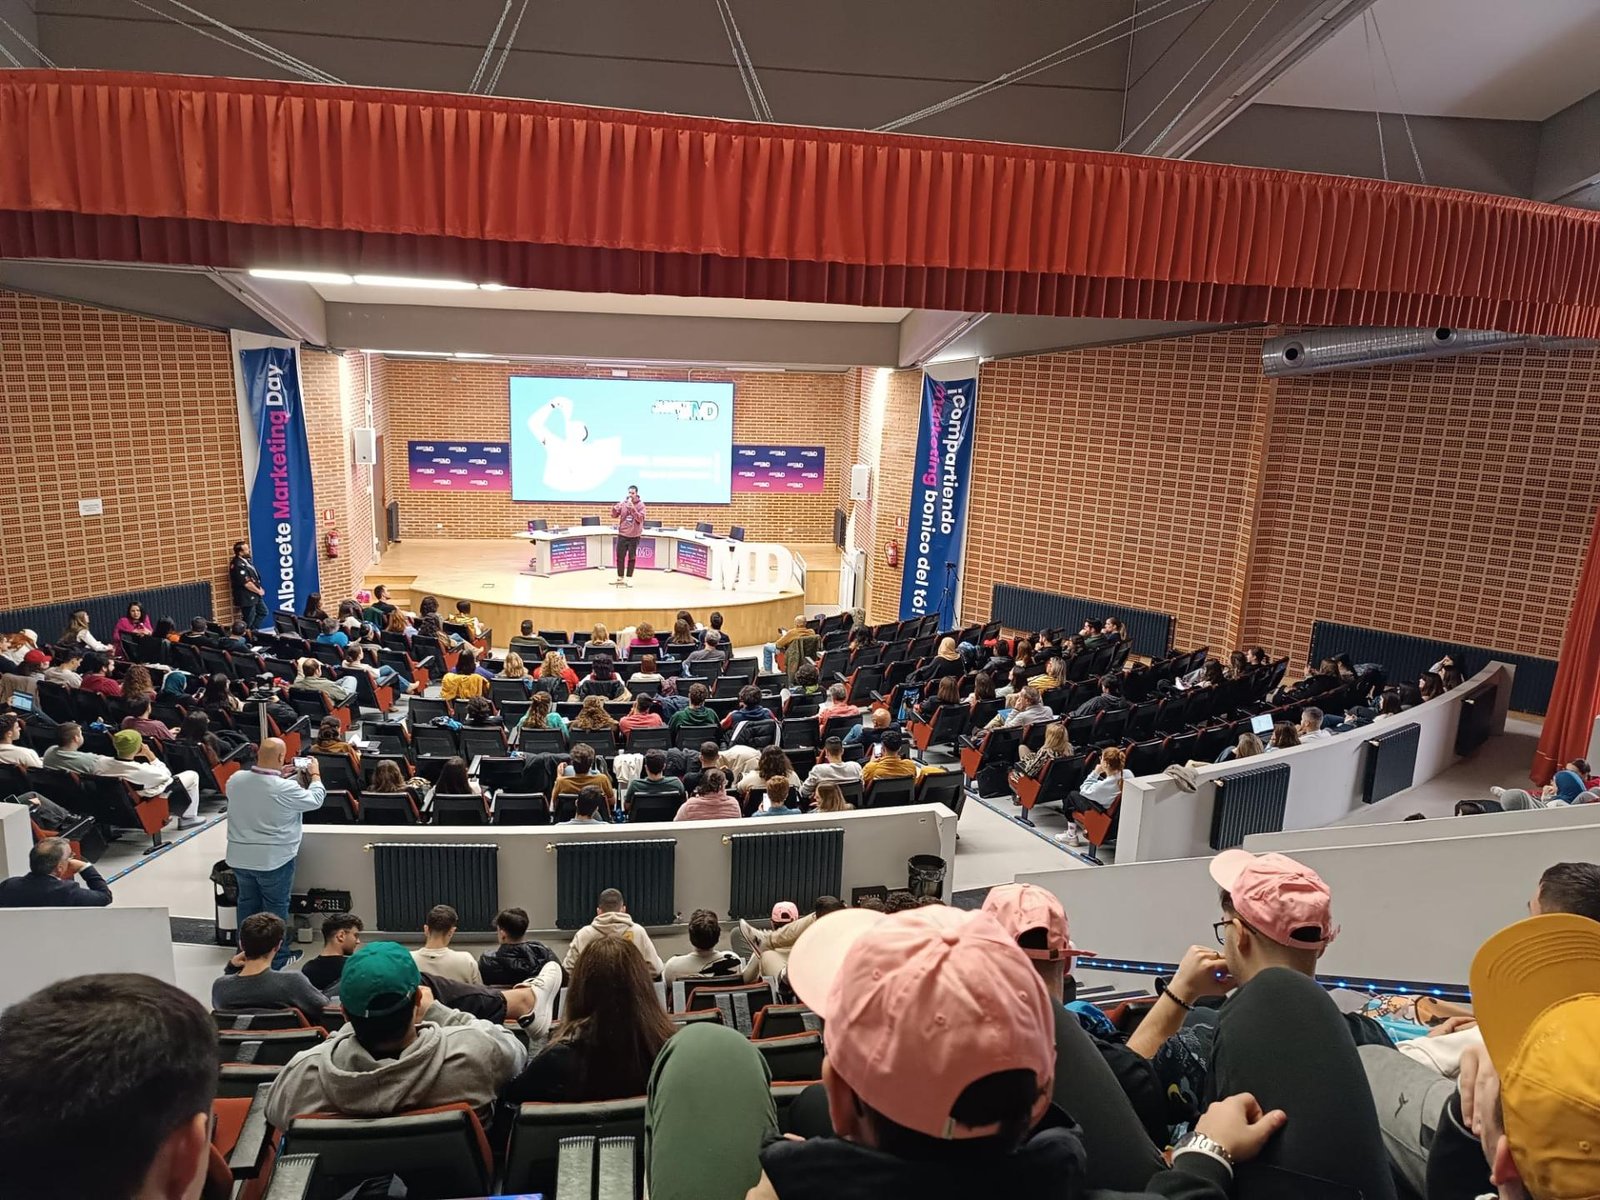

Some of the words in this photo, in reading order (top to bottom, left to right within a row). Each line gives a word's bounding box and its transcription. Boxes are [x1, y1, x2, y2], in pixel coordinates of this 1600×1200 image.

[266, 363, 283, 406] Day
[266, 411, 291, 519] Marketing
[941, 388, 966, 534] ¡Compartiendo
[919, 490, 938, 554] bonico
[275, 522, 295, 612] Albacete
[915, 557, 931, 587] del
[911, 589, 928, 615] tó!
